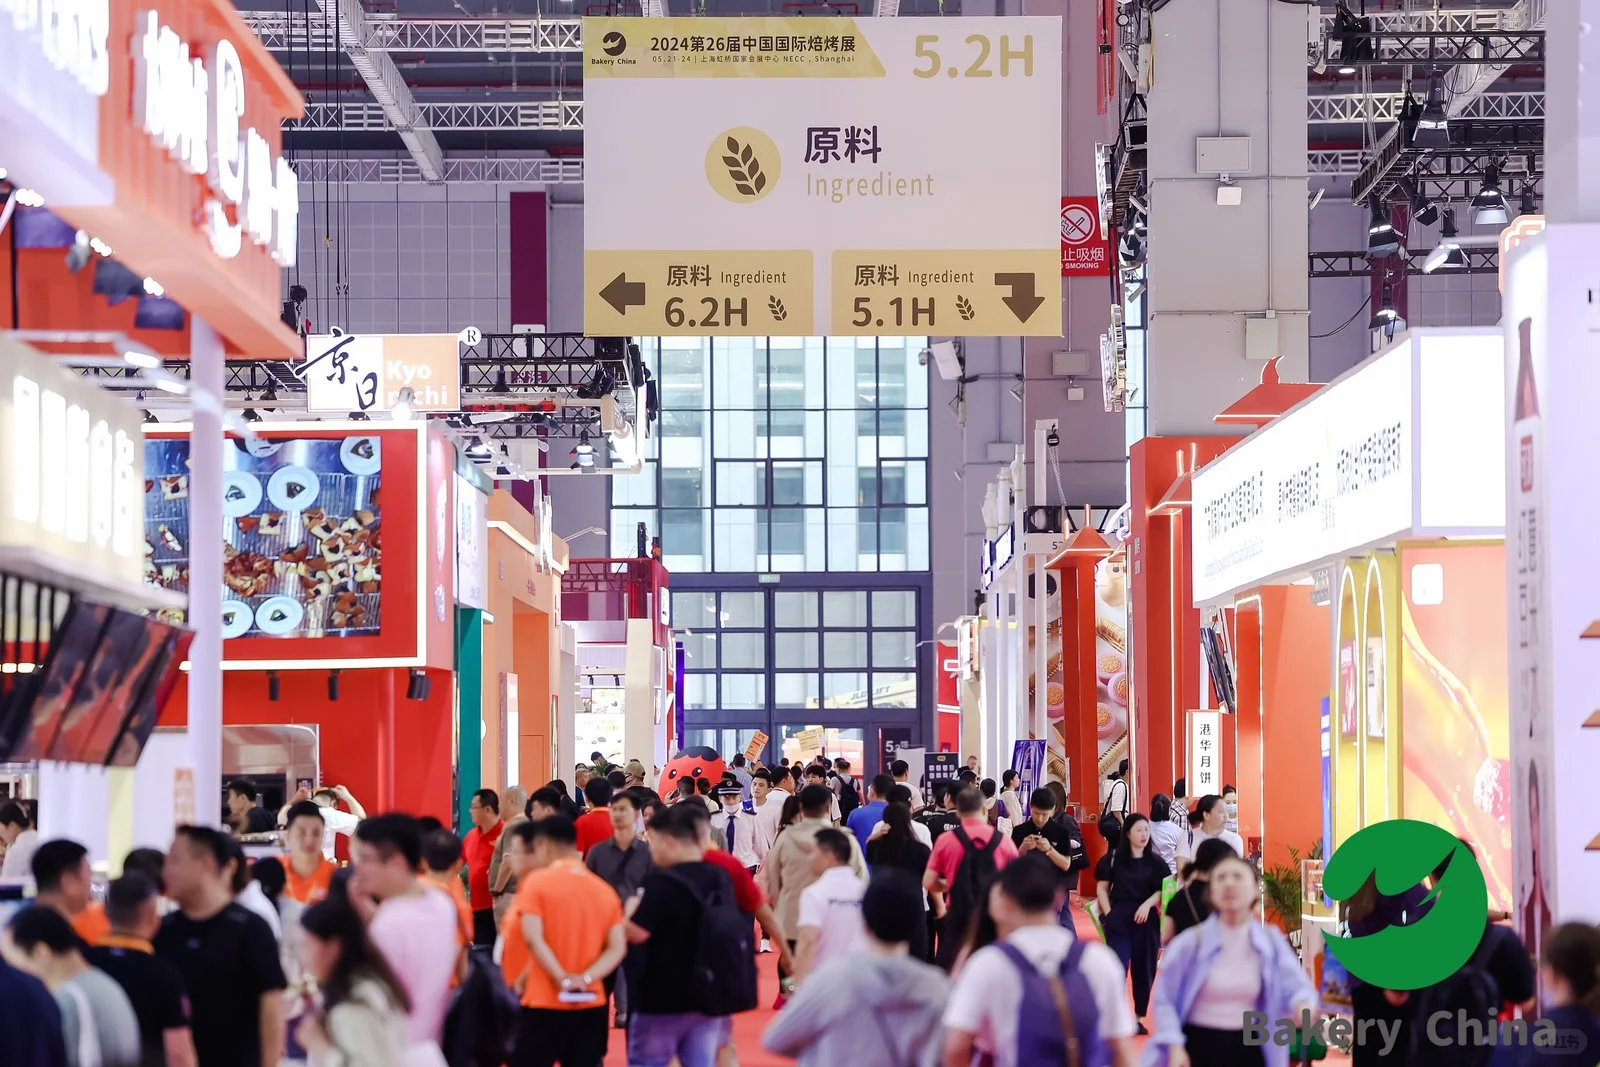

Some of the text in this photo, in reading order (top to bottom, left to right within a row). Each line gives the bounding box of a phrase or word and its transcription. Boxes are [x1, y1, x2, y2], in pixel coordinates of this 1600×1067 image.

[651, 36, 855, 53] 2024第26届中国国际焙烤展
[591, 58, 614, 66] Bakery
[653, 55, 691, 63] 05.21-24
[913, 34, 1033, 79] 5.2H
[805, 125, 881, 163] 原料
[807, 172, 934, 203] Ingredient
[667, 265, 786, 287] 原料 Ingredient
[855, 265, 974, 287] 原料 Ingredient
[665, 297, 747, 327] 6.2H
[853, 297, 935, 327] 5.1H
[386, 360, 433, 383] Kyo
[388, 386, 448, 405] nchi
[1199, 723, 1211, 783] 港华月饼
